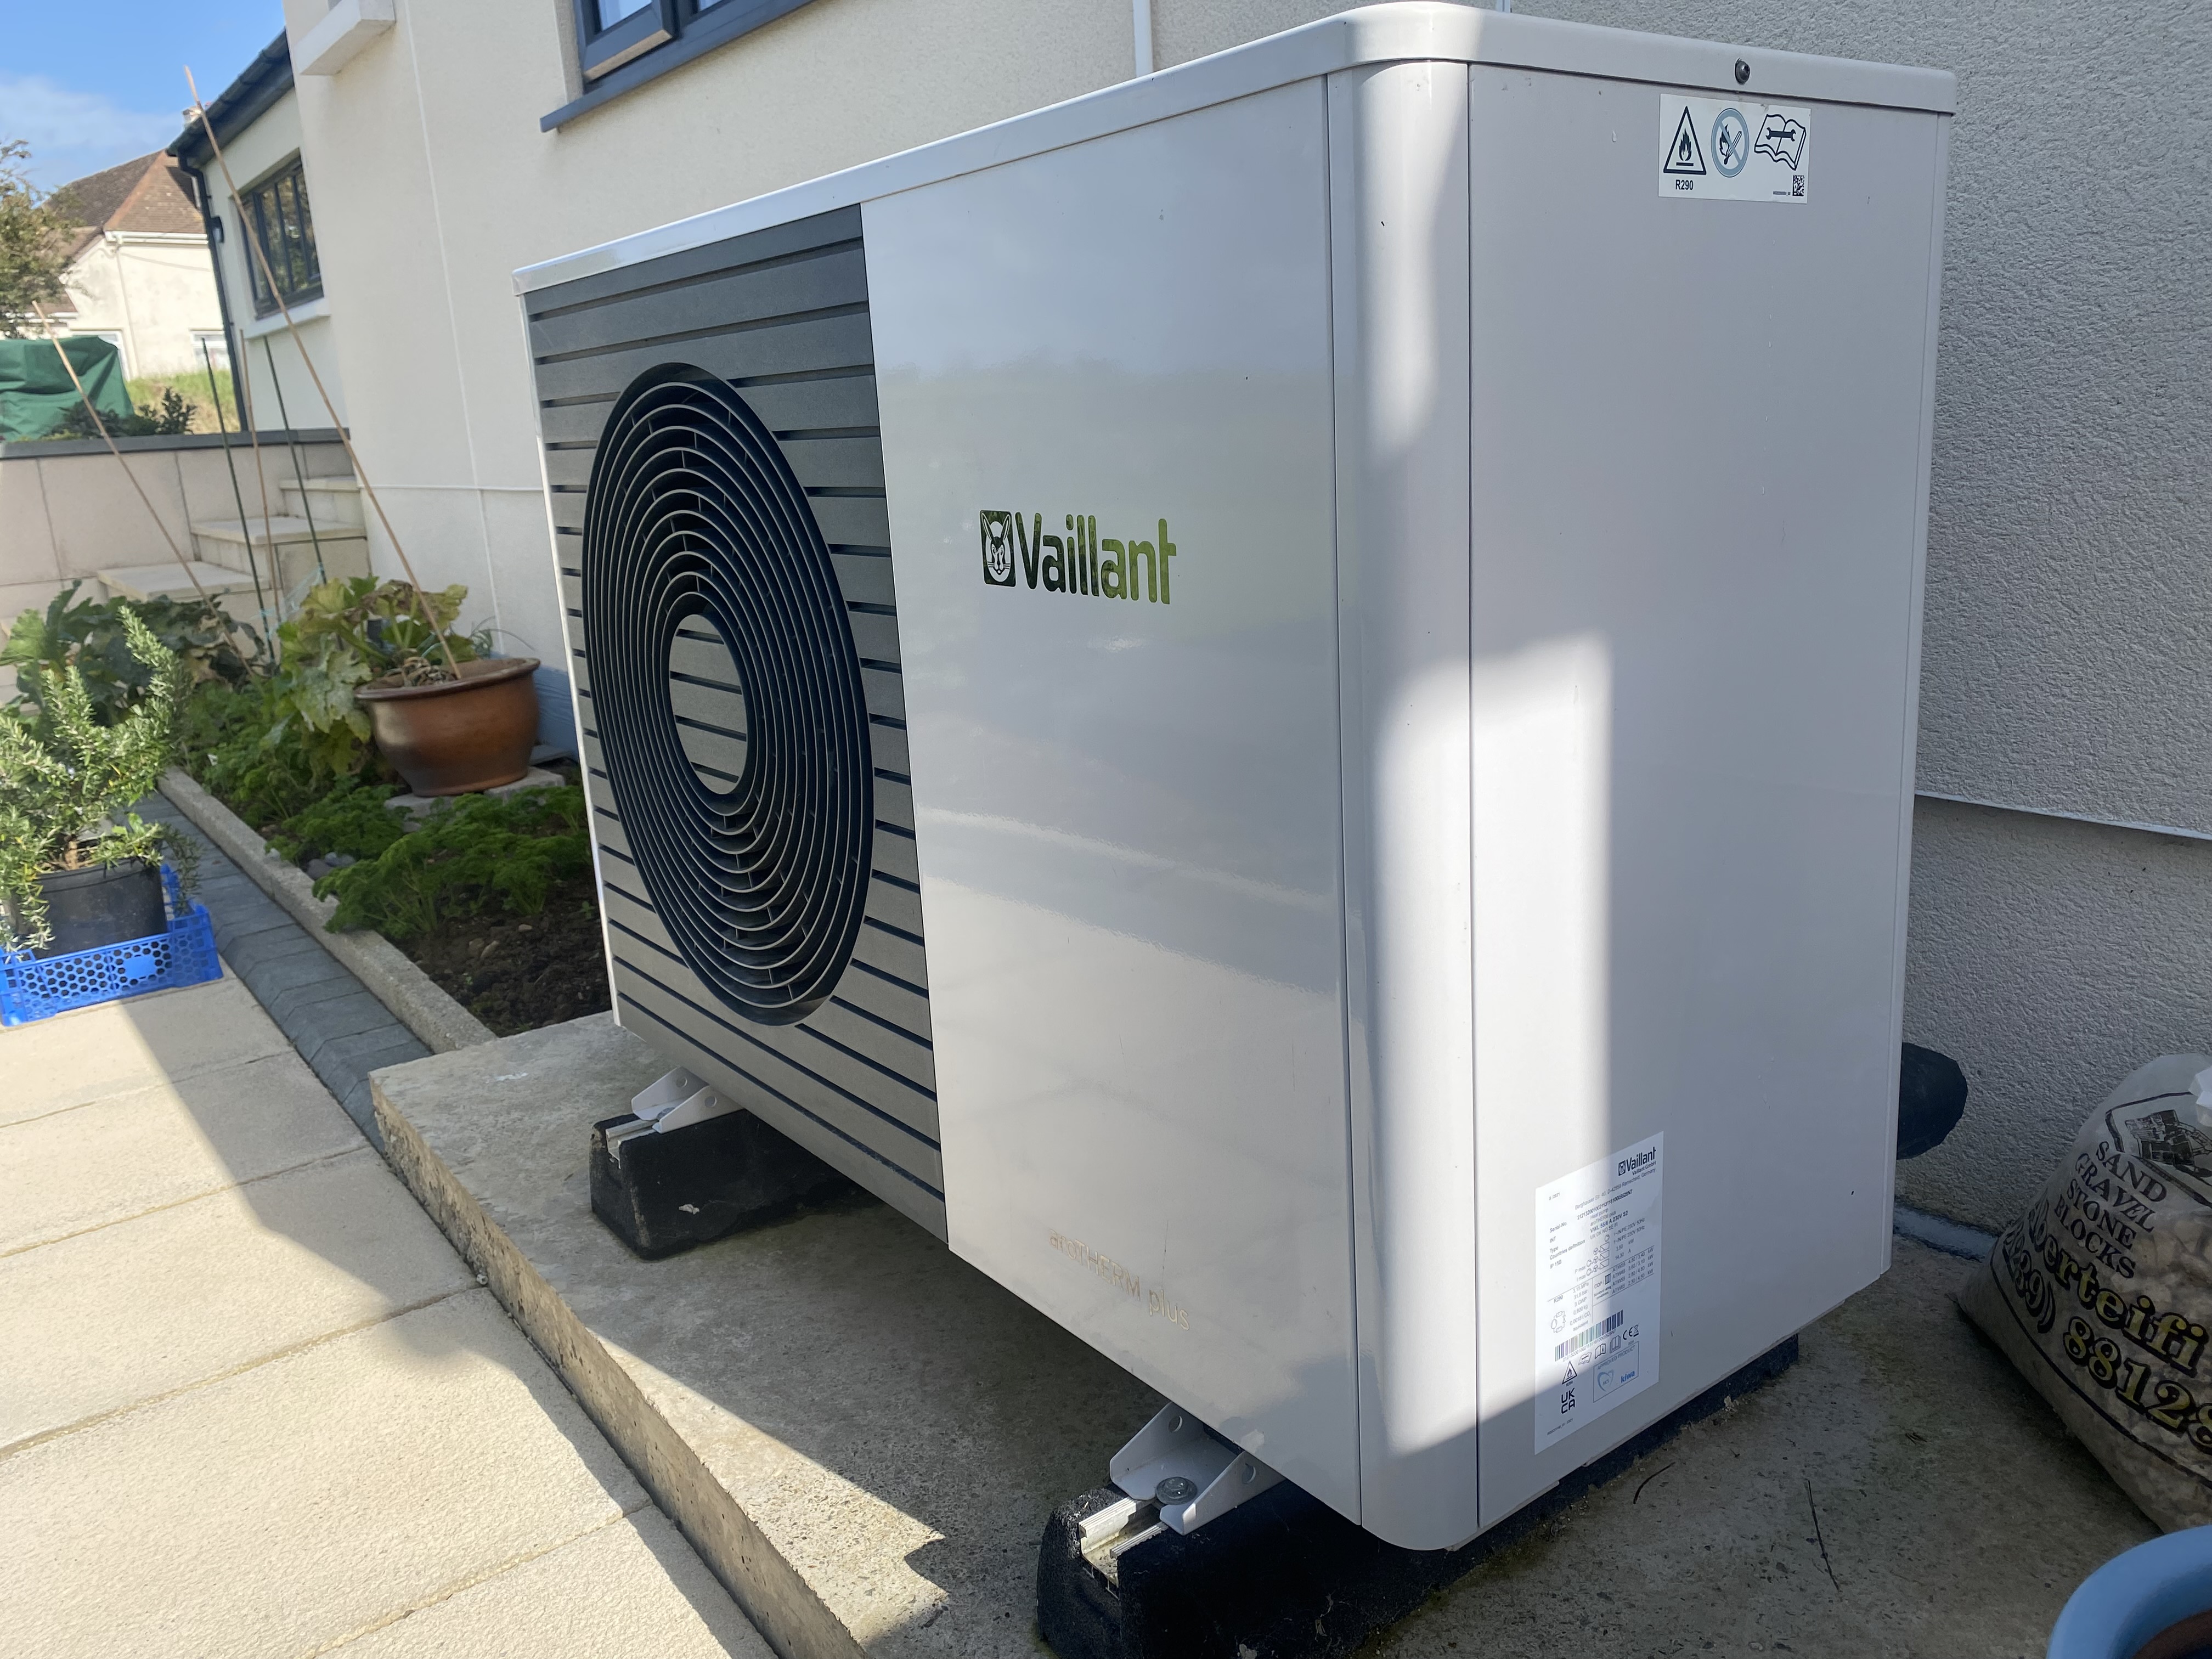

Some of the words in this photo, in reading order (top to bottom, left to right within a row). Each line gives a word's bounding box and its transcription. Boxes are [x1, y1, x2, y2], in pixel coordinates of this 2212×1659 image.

[1675, 179, 1694, 191] R290
[1014, 511, 1177, 605] Vaillant
[1626, 1147, 1656, 1172] Vaillant
[1632, 1167, 1644, 1176] Vaillant
[2096, 1141, 2168, 1202] SAND
[1575, 1198, 1594, 1210] Berghauser
[1641, 1169, 1655, 1178] Germany
[2075, 1153, 2156, 1233] GRAVEL
[1590, 1215, 1608, 1226] aroTHERM
[2067, 1178, 2137, 1249] STONE
[1590, 1225, 1599, 1233] VWL
[2055, 1194, 2136, 1279] BLOCKS
[1549, 1249, 1567, 1260] Countries
[1568, 1239, 1585, 1250] definition
[1549, 1246, 1558, 1254] Type
[1048, 1228, 1141, 1302] aroTHERM
[1148, 1289, 1190, 1331] plus
[1597, 1356, 1617, 1369] APPROVED
[1618, 1346, 1635, 1358] PRODUCT
[1621, 1370, 1634, 1383] kiwa
[1561, 1388, 1575, 1404] UK
[1561, 1398, 1575, 1414] CA
